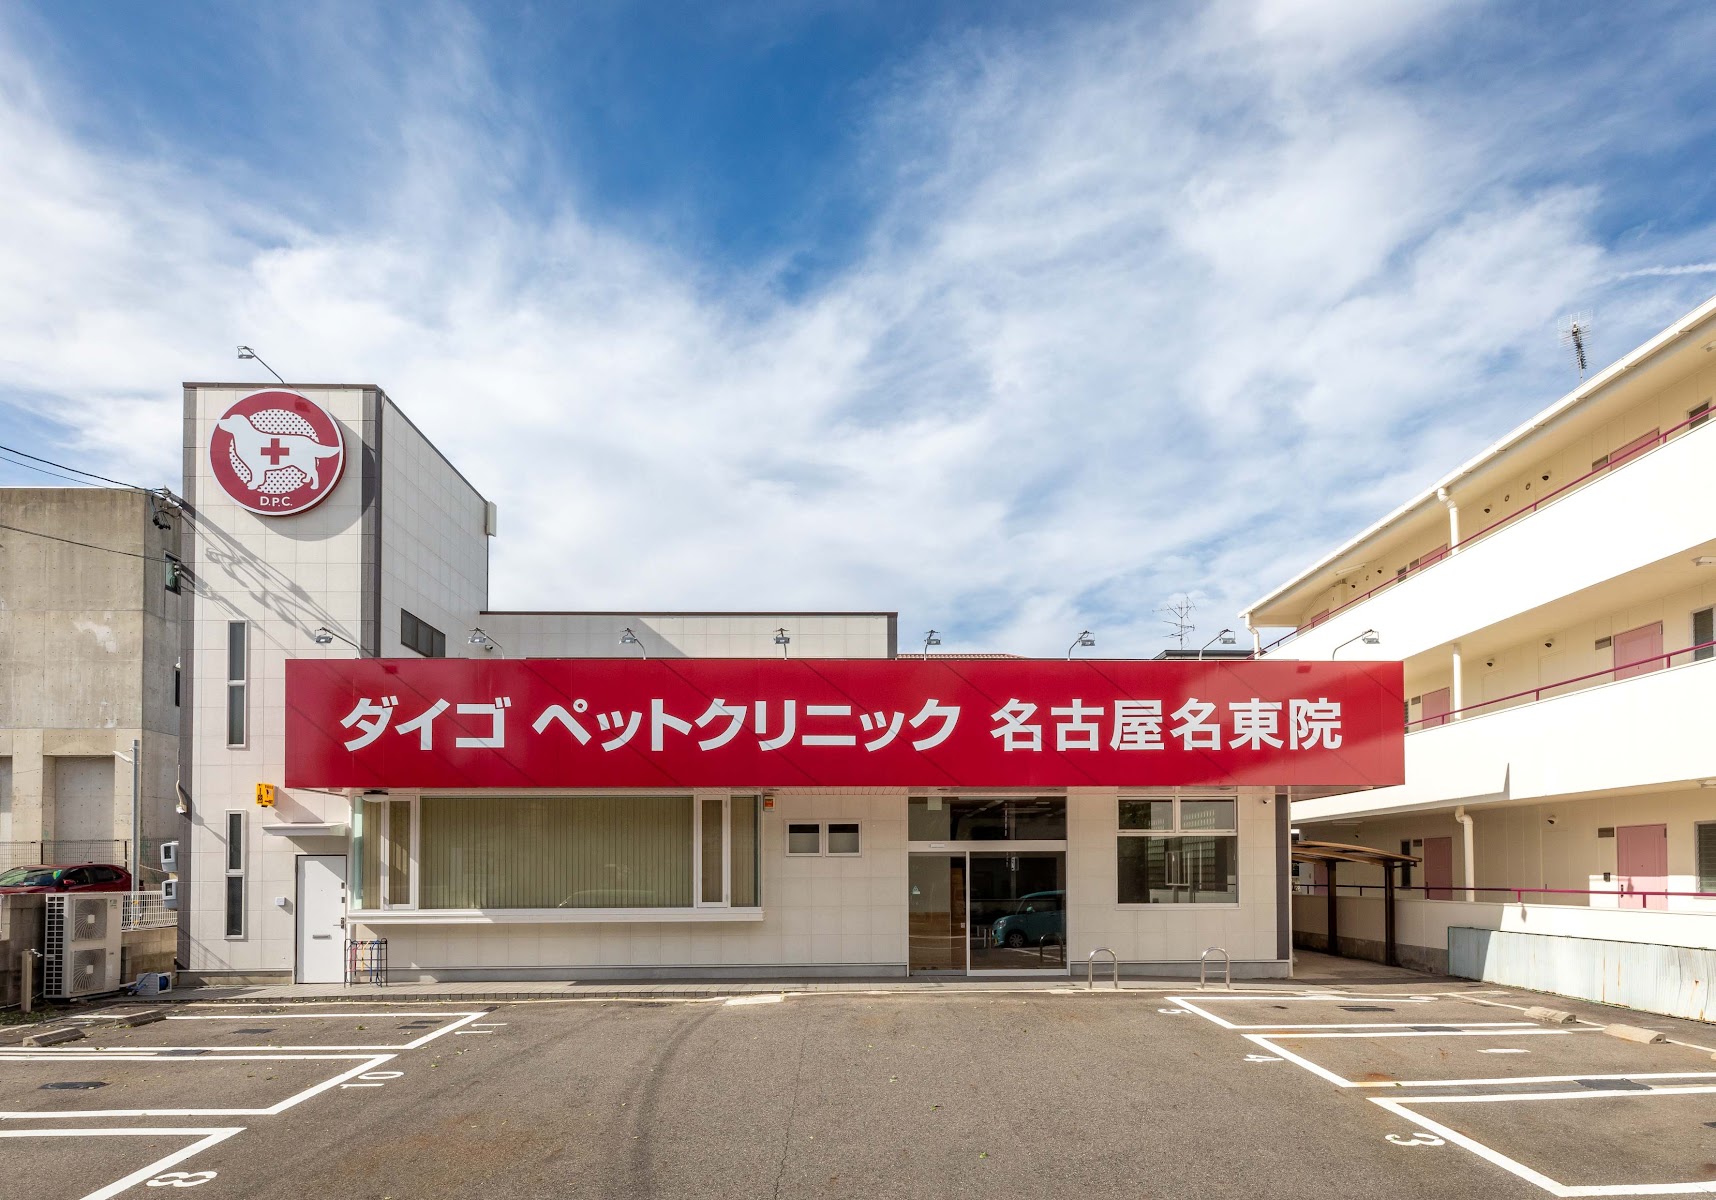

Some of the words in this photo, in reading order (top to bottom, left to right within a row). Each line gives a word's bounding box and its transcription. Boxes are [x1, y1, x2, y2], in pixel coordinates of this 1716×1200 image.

[260, 496, 293, 507] D.P.C.
[340, 697, 511, 751] ダイゴ
[532, 697, 960, 752] ペットクリニック
[990, 698, 1342, 751] 名古屋名東院
[1243, 1054, 1285, 1063] 4
[340, 1071, 404, 1089] 10
[1384, 1132, 1446, 1147] 3
[146, 1171, 218, 1188] 8
